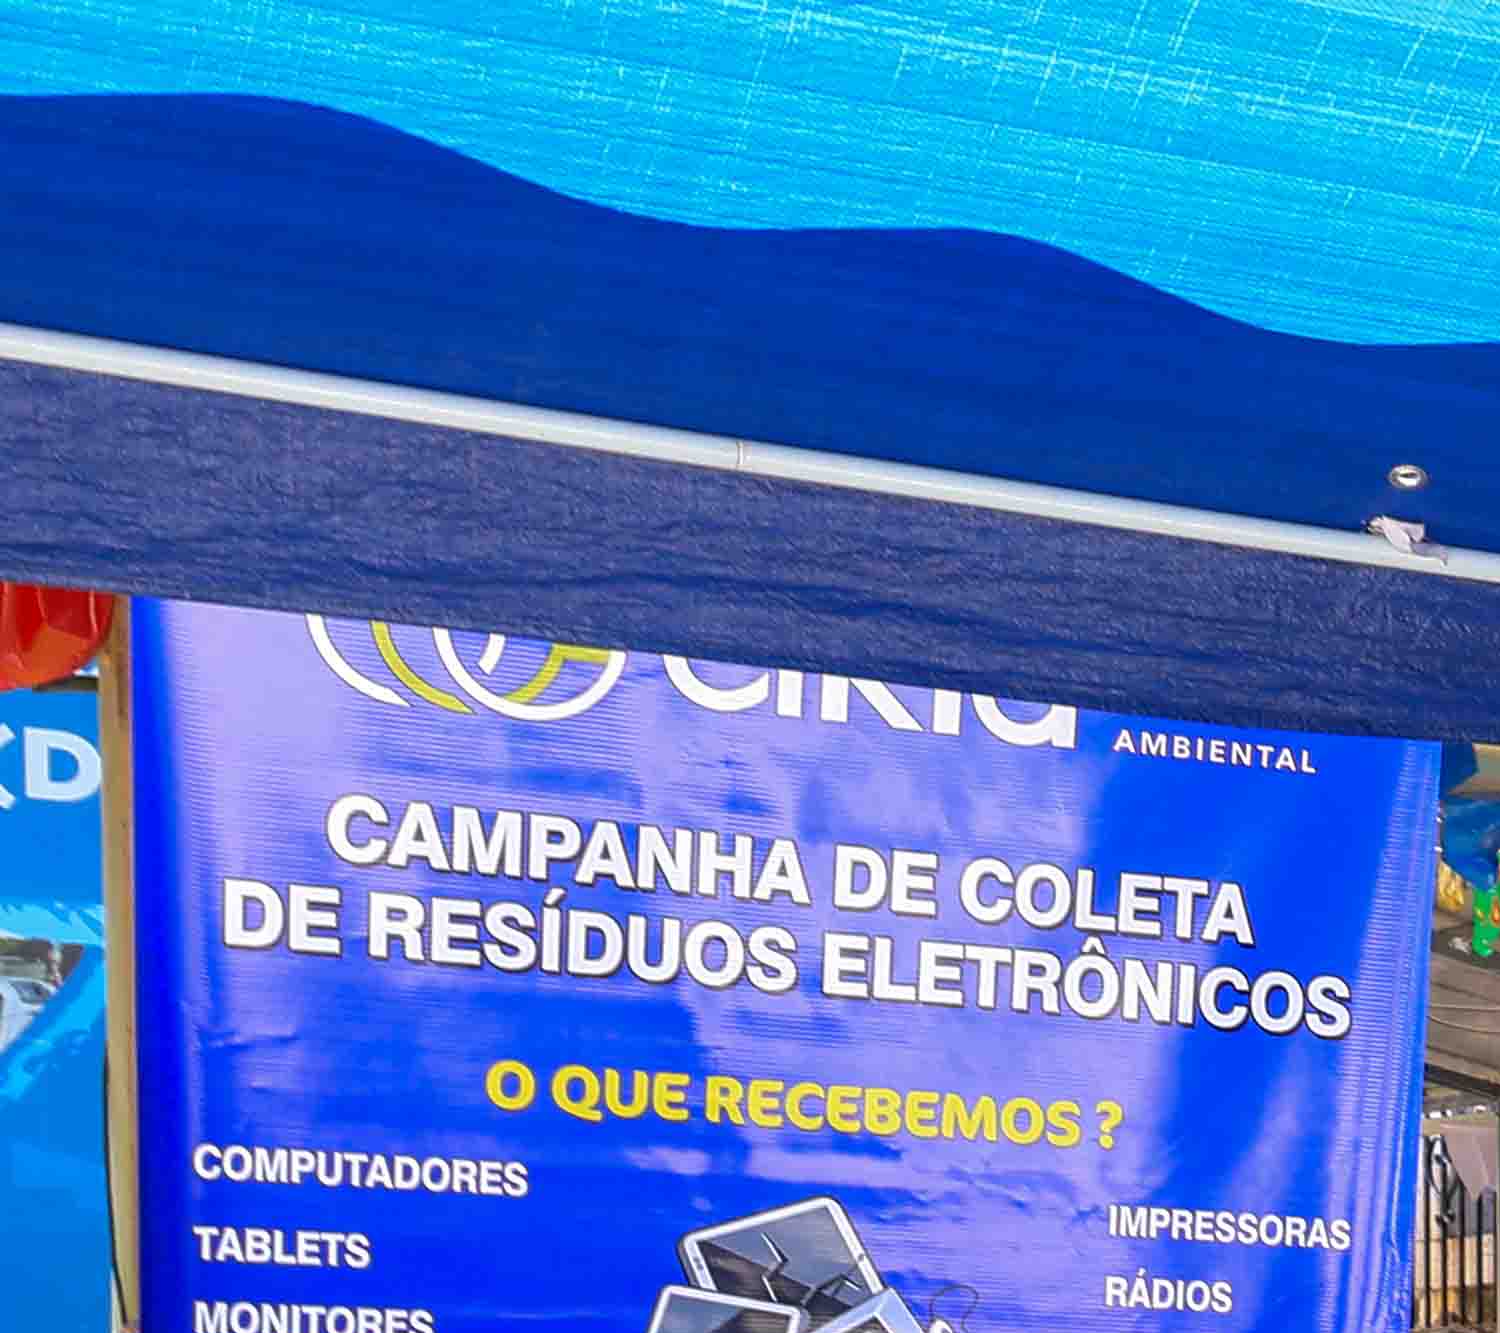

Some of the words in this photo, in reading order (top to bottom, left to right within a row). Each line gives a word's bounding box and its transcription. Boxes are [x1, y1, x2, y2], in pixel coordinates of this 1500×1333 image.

[0, 722, 102, 808] D
[1113, 729, 1317, 774] AMBIENTAL
[326, 793, 810, 906] CAMPANHA
[833, 843, 939, 918] DE
[959, 857, 1256, 947] COLETA
[223, 878, 343, 955] DE
[367, 887, 799, 993] RESÍDUOS
[822, 932, 1352, 1040] ELETRÔNICOS
[485, 1059, 535, 1113] O
[551, 1063, 689, 1125] QUE
[706, 1079, 1081, 1148] RECEBEMOS
[1096, 1100, 1123, 1149] ?
[192, 1144, 529, 1197] COMPUTADORES
[194, 1226, 371, 1269] TABLETS
[1108, 1205, 1352, 1251] IMPRESSORAS
[1104, 1267, 1233, 1314] RÁDIOS
